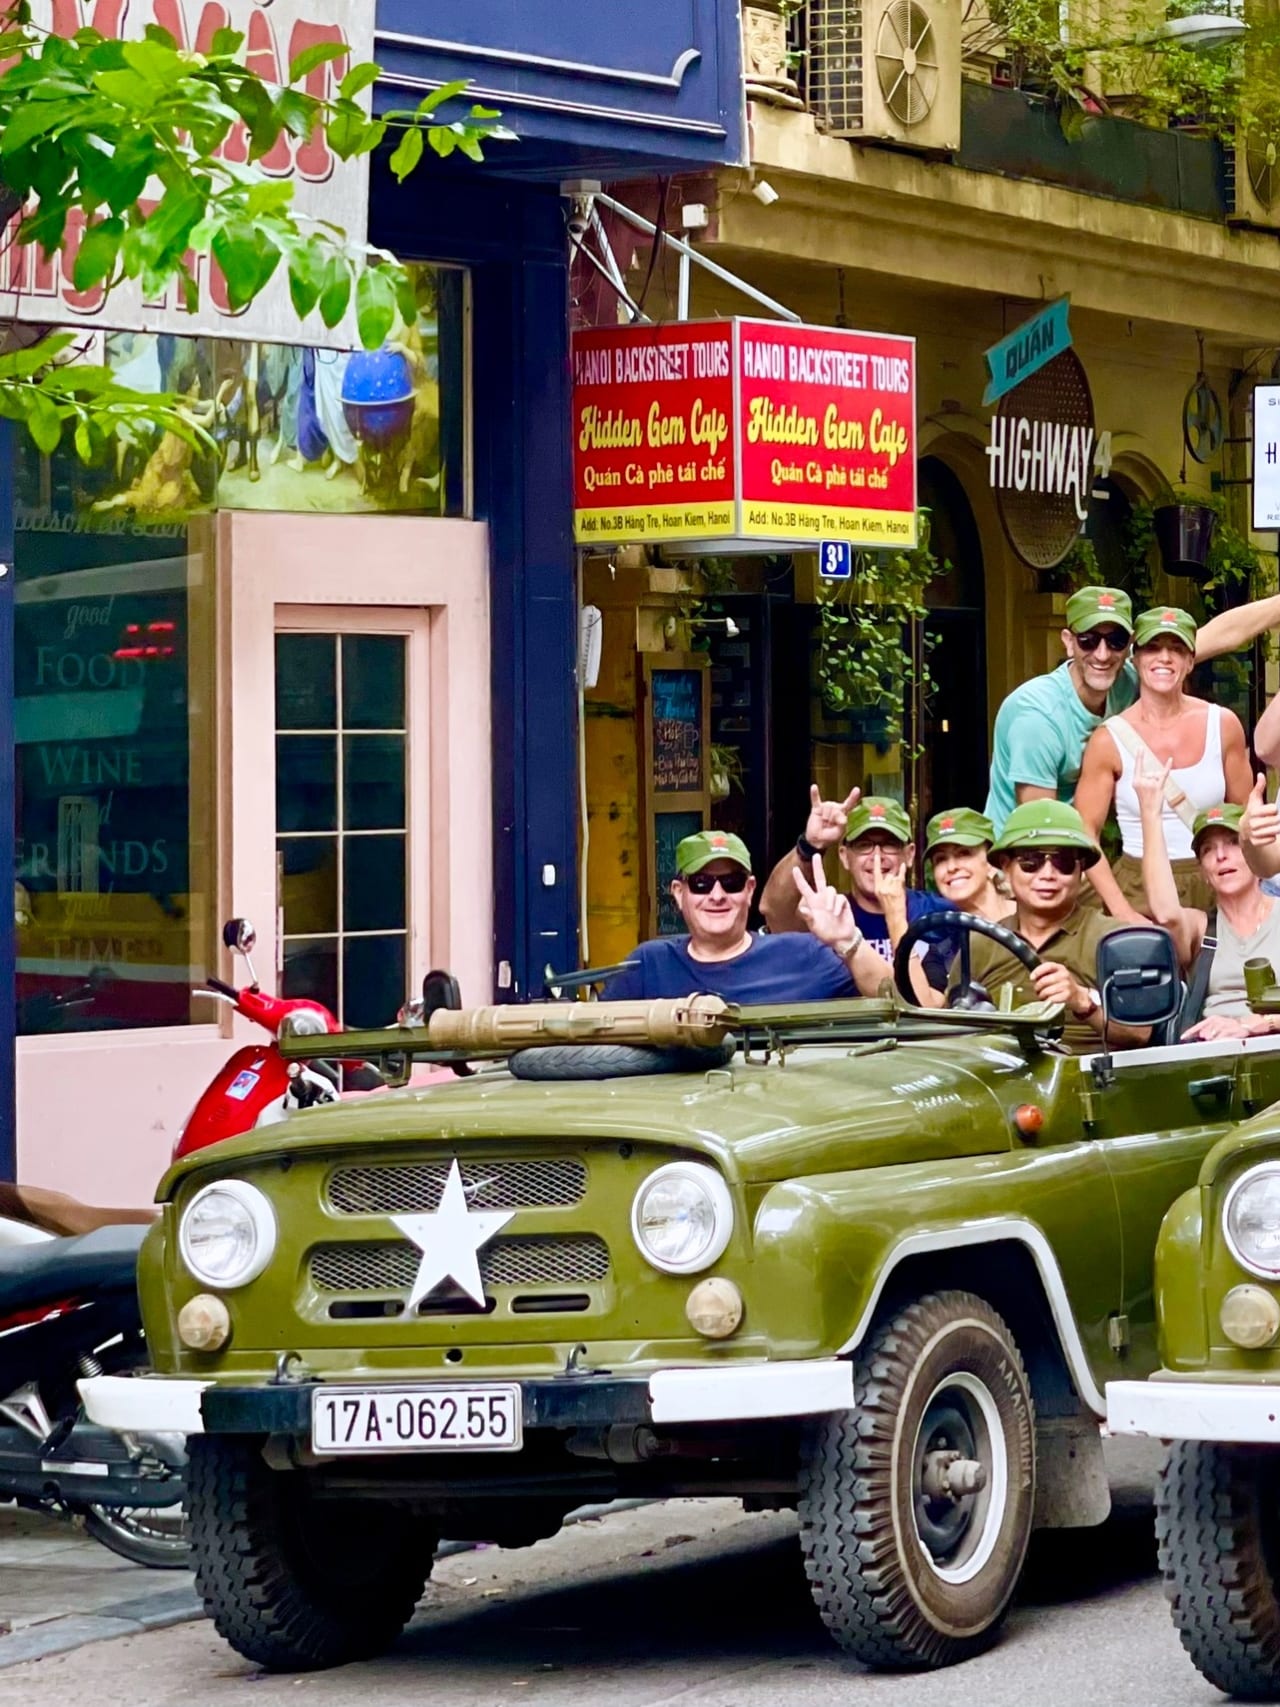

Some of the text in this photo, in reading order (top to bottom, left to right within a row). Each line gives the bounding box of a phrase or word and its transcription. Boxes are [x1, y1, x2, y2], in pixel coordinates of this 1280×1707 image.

[576, 340, 729, 386] HANOI BACKSTREET TOURS
[744, 341, 909, 393] HANOI BACKSTREET TOURS
[1005, 317, 1054, 379] QUÁN
[579, 398, 728, 455] Hidden Gem Cafe
[747, 396, 908, 465] Hidden Gem Cafe
[584, 457, 726, 492] Quán Cà phê tái chế
[771, 459, 803, 486] Quán
[806, 462, 822, 484] Cà
[850, 467, 864, 487] tái
[868, 467, 888, 490] chế
[985, 416, 1112, 521] HIGHWAY 4
[749, 510, 769, 526] Add:
[771, 512, 797, 528] No.3B
[839, 517, 860, 530] Hoan
[887, 520, 909, 534] Hanoi
[64, 594, 116, 640] good
[326, 1396, 507, 1442] 17A-062.55
